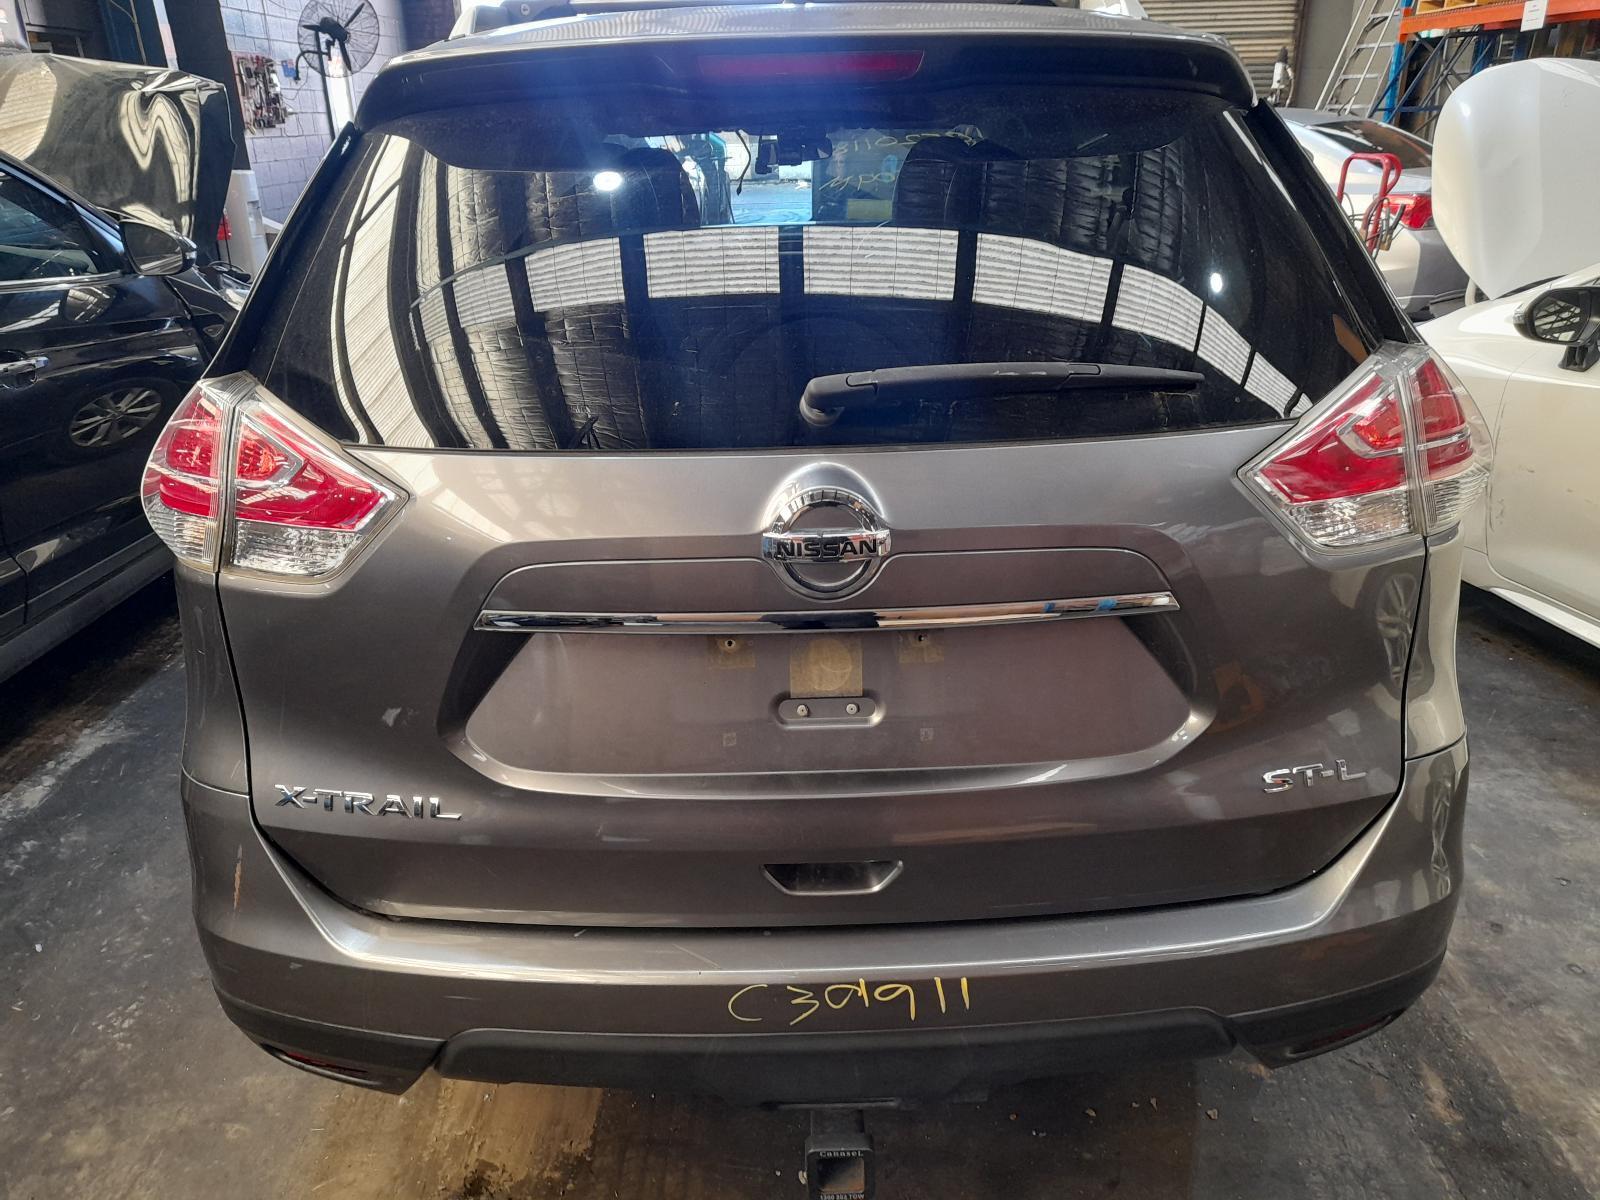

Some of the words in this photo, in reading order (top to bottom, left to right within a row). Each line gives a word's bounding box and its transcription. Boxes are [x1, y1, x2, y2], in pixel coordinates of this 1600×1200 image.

[776, 538, 877, 557] NISSAN
[1262, 759, 1367, 793] ST-L
[274, 784, 463, 820] X-TRAIL
